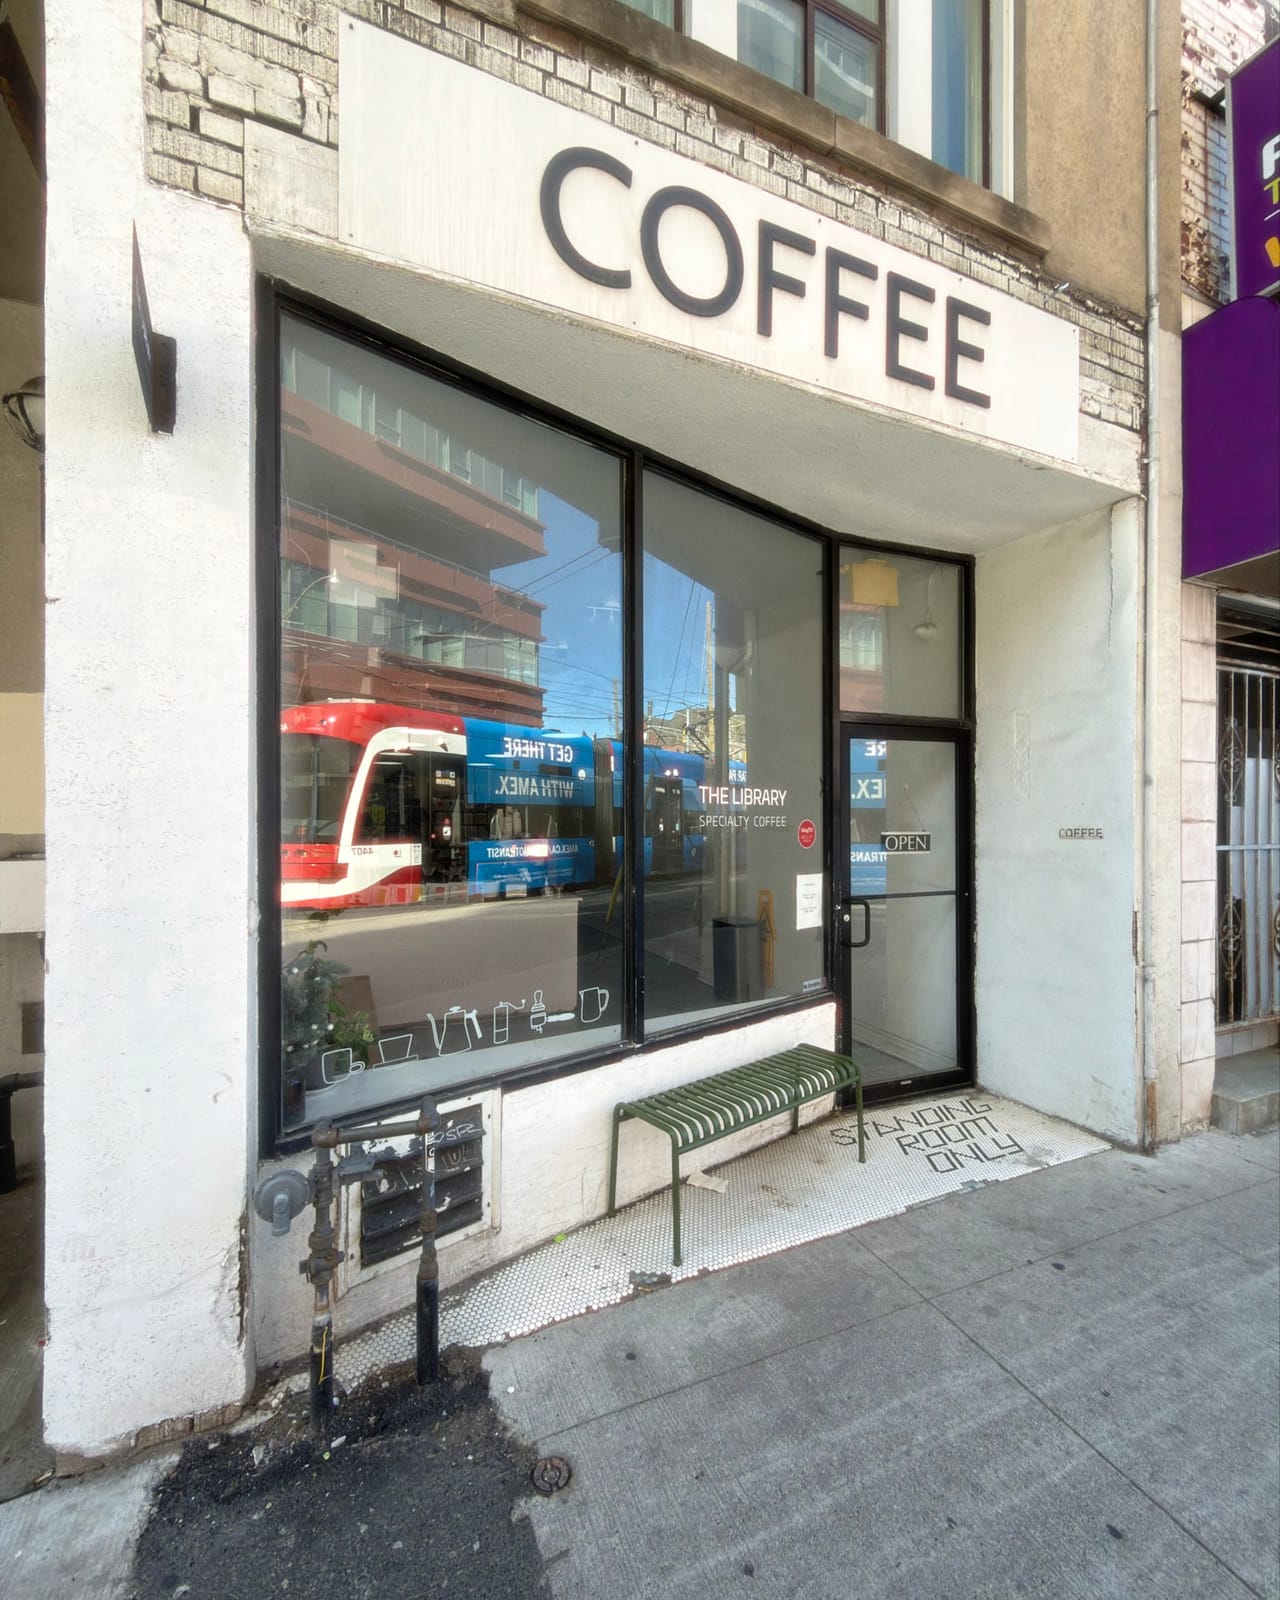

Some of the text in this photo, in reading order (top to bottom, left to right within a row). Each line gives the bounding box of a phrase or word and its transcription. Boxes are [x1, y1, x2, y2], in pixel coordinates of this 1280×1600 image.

[540, 146, 990, 408] COFFEE
[698, 785, 788, 806] THE LIBRARY
[699, 815, 787, 828] SPECIALTY COFFEE
[1058, 827, 1103, 839] COFFEE
[885, 835, 927, 851] OPEN
[830, 1099, 993, 1146] STANDING
[895, 1116, 998, 1155] ROOM
[925, 1133, 1025, 1174] ONLY
